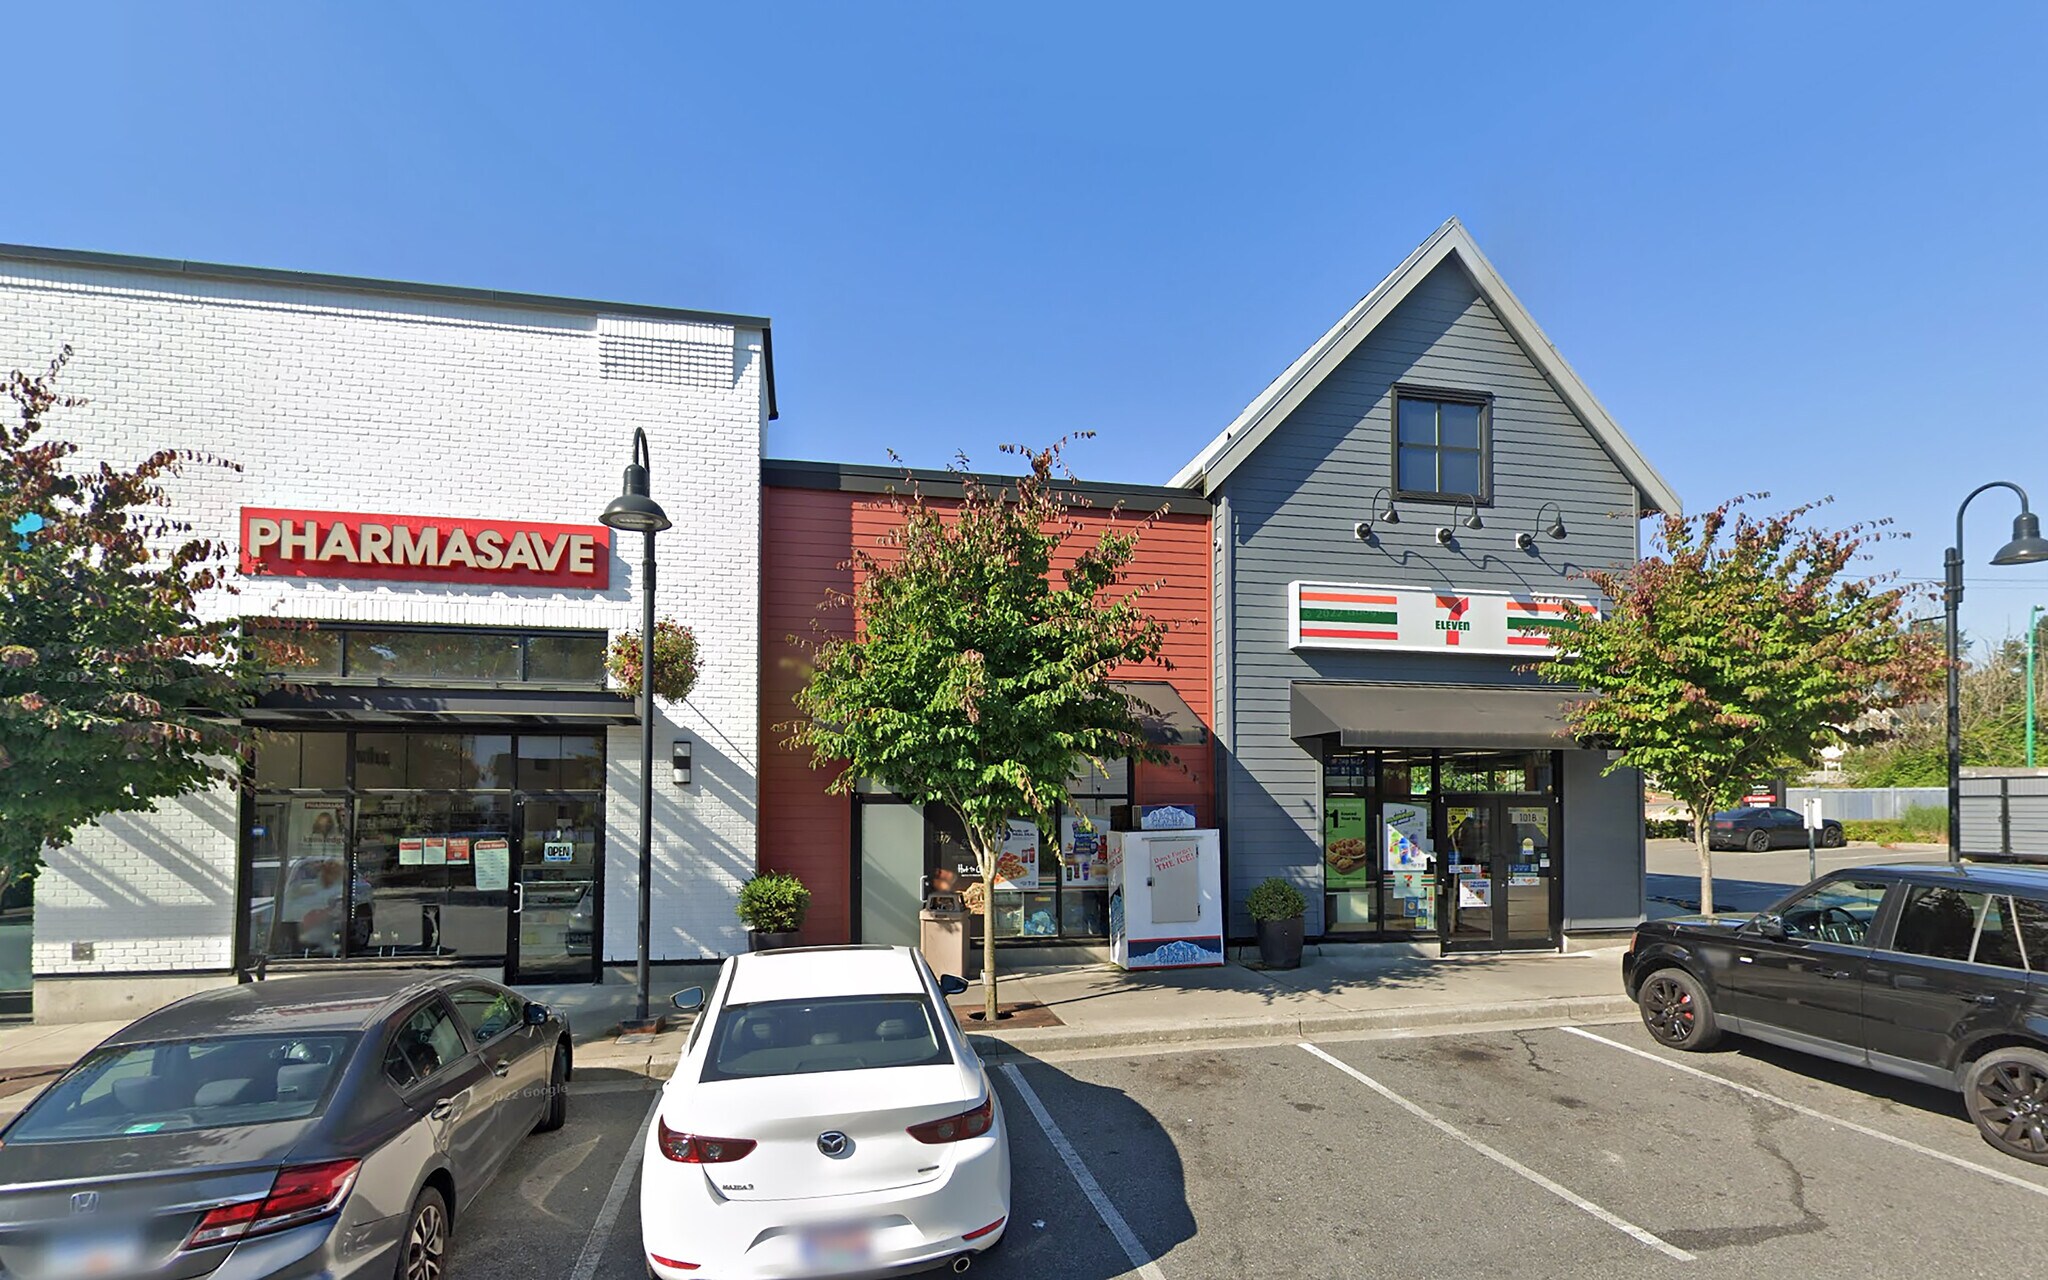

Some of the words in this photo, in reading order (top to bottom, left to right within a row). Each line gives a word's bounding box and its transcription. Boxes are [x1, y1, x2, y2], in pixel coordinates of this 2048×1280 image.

[249, 517, 595, 573] PHARMASAVE
[1435, 596, 1469, 646] 7
[547, 846, 570, 857] OPEN
[1156, 860, 1175, 871] THE
[1158, 954, 1198, 963] GLACIER
